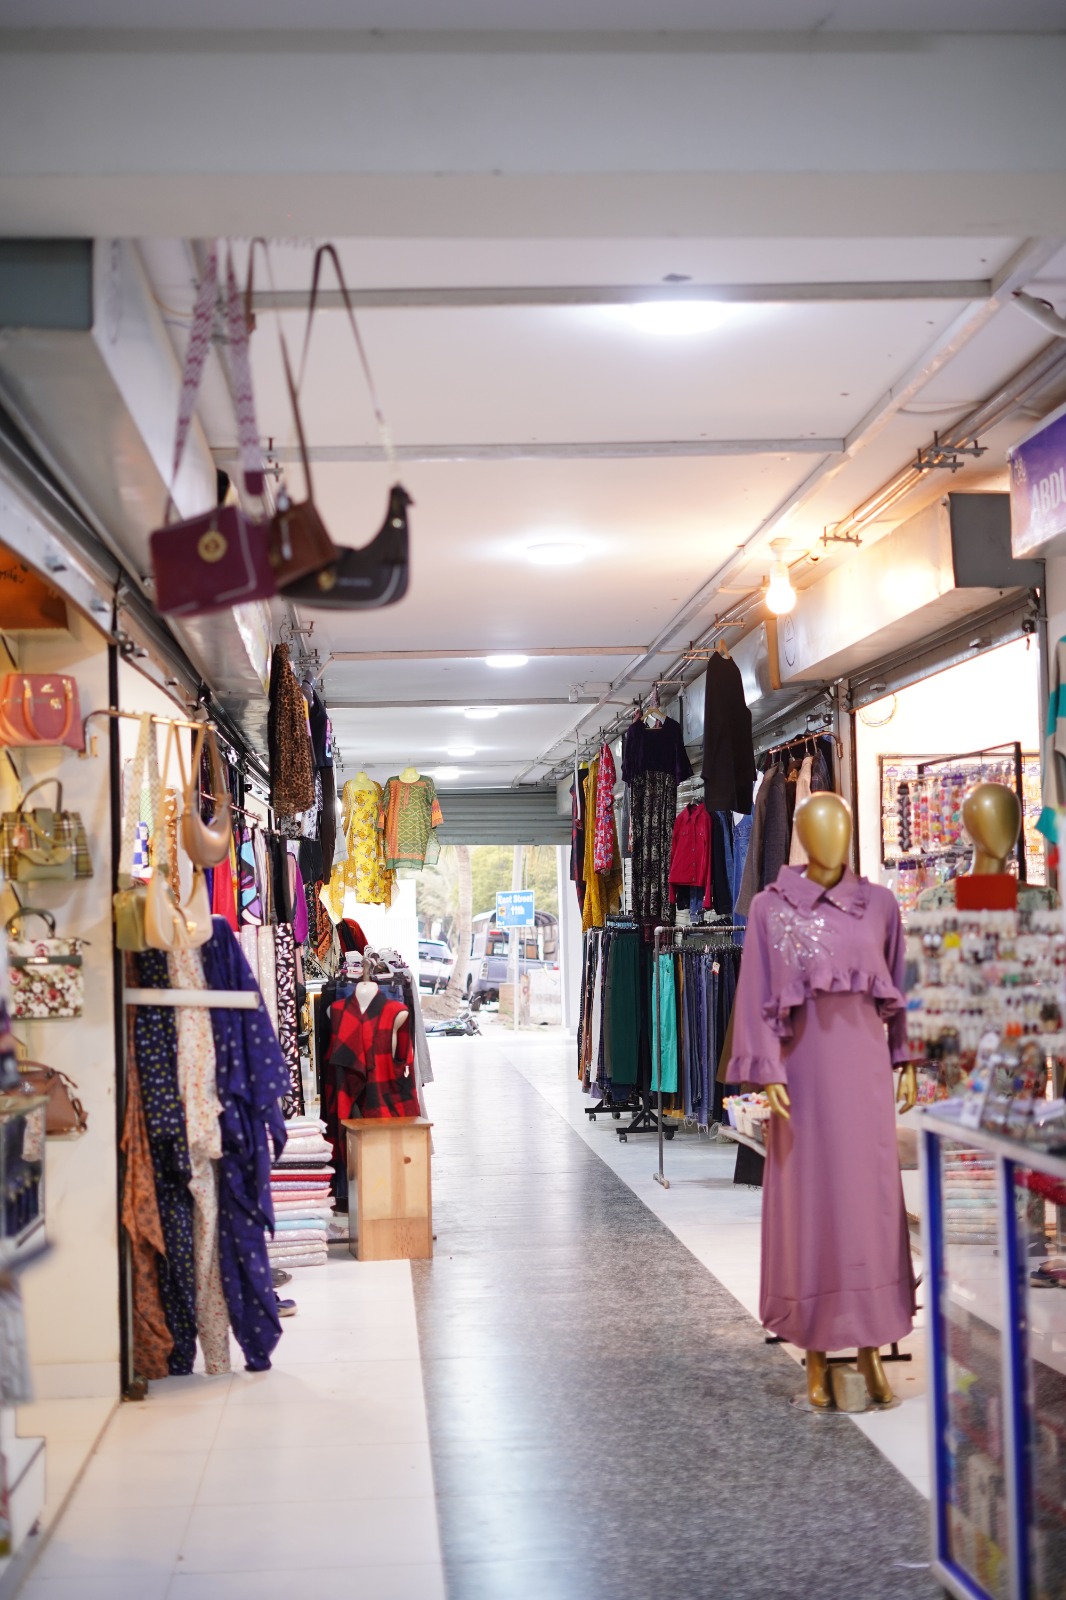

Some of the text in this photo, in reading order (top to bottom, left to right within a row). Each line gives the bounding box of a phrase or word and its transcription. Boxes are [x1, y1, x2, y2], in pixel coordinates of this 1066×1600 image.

[498, 894, 533, 904] East Street
[510, 905, 525, 915] 11th
